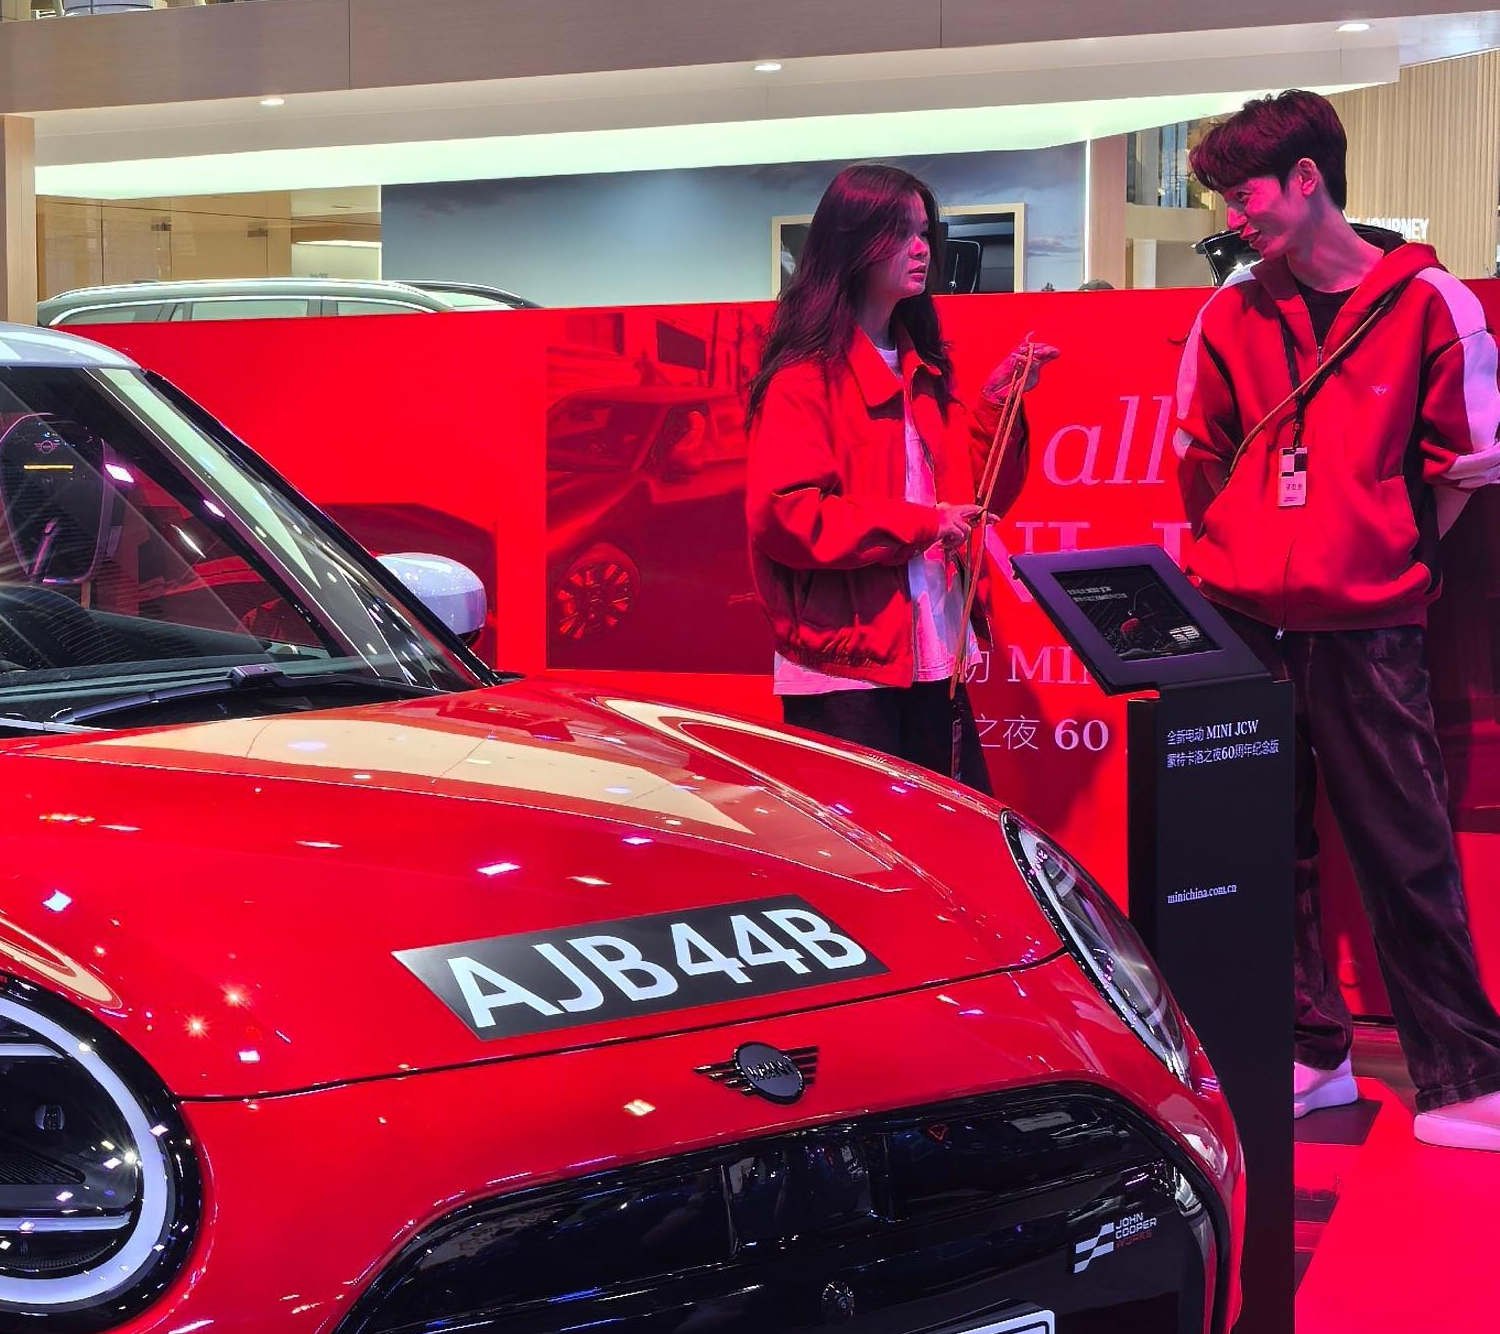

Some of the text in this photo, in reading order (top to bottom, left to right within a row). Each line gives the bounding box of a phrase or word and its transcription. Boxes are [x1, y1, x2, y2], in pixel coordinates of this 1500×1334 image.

[1054, 718, 1109, 752] 60
[1167, 719, 1260, 746] 全新电动 MINI JCW
[1115, 1211, 1144, 1230] JOHN
[1115, 1217, 1158, 1240] COOPER
